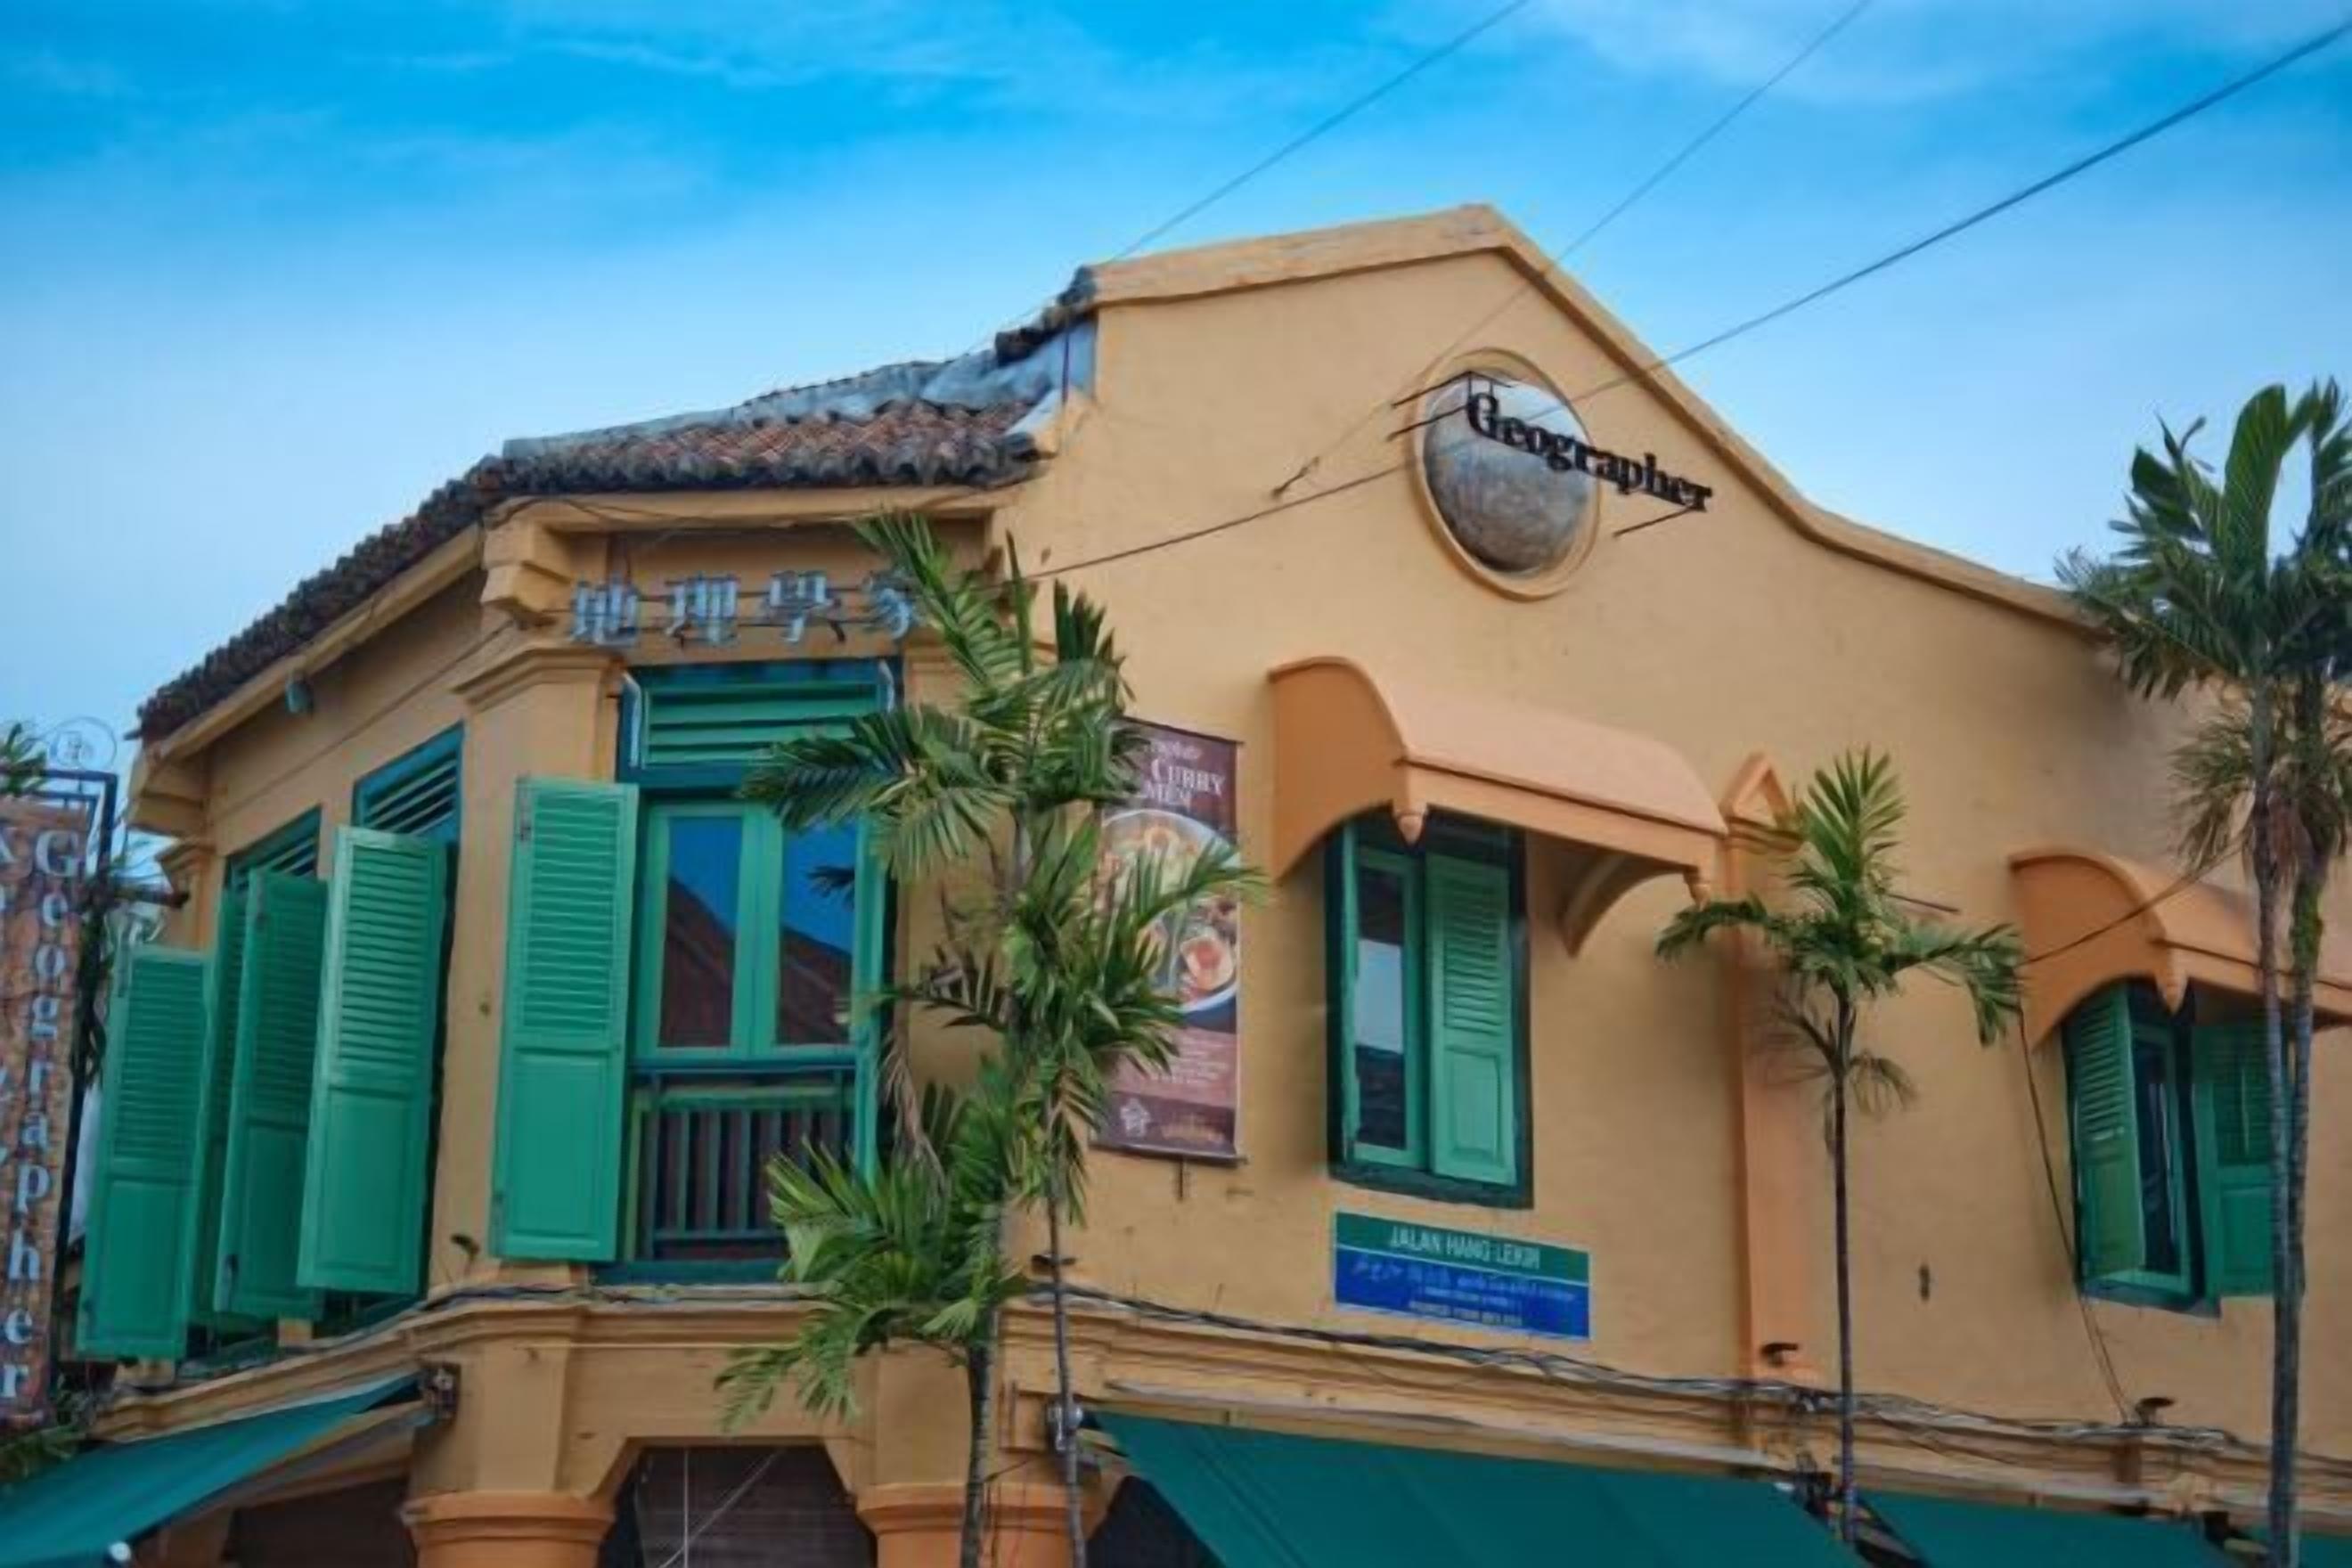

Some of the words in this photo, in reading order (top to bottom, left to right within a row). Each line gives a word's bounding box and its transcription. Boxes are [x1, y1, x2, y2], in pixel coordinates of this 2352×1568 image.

[1467, 393, 1712, 511] Geographer
[0, 829, 81, 1398] Geographer
[1391, 1224, 1441, 1251] JALAN
